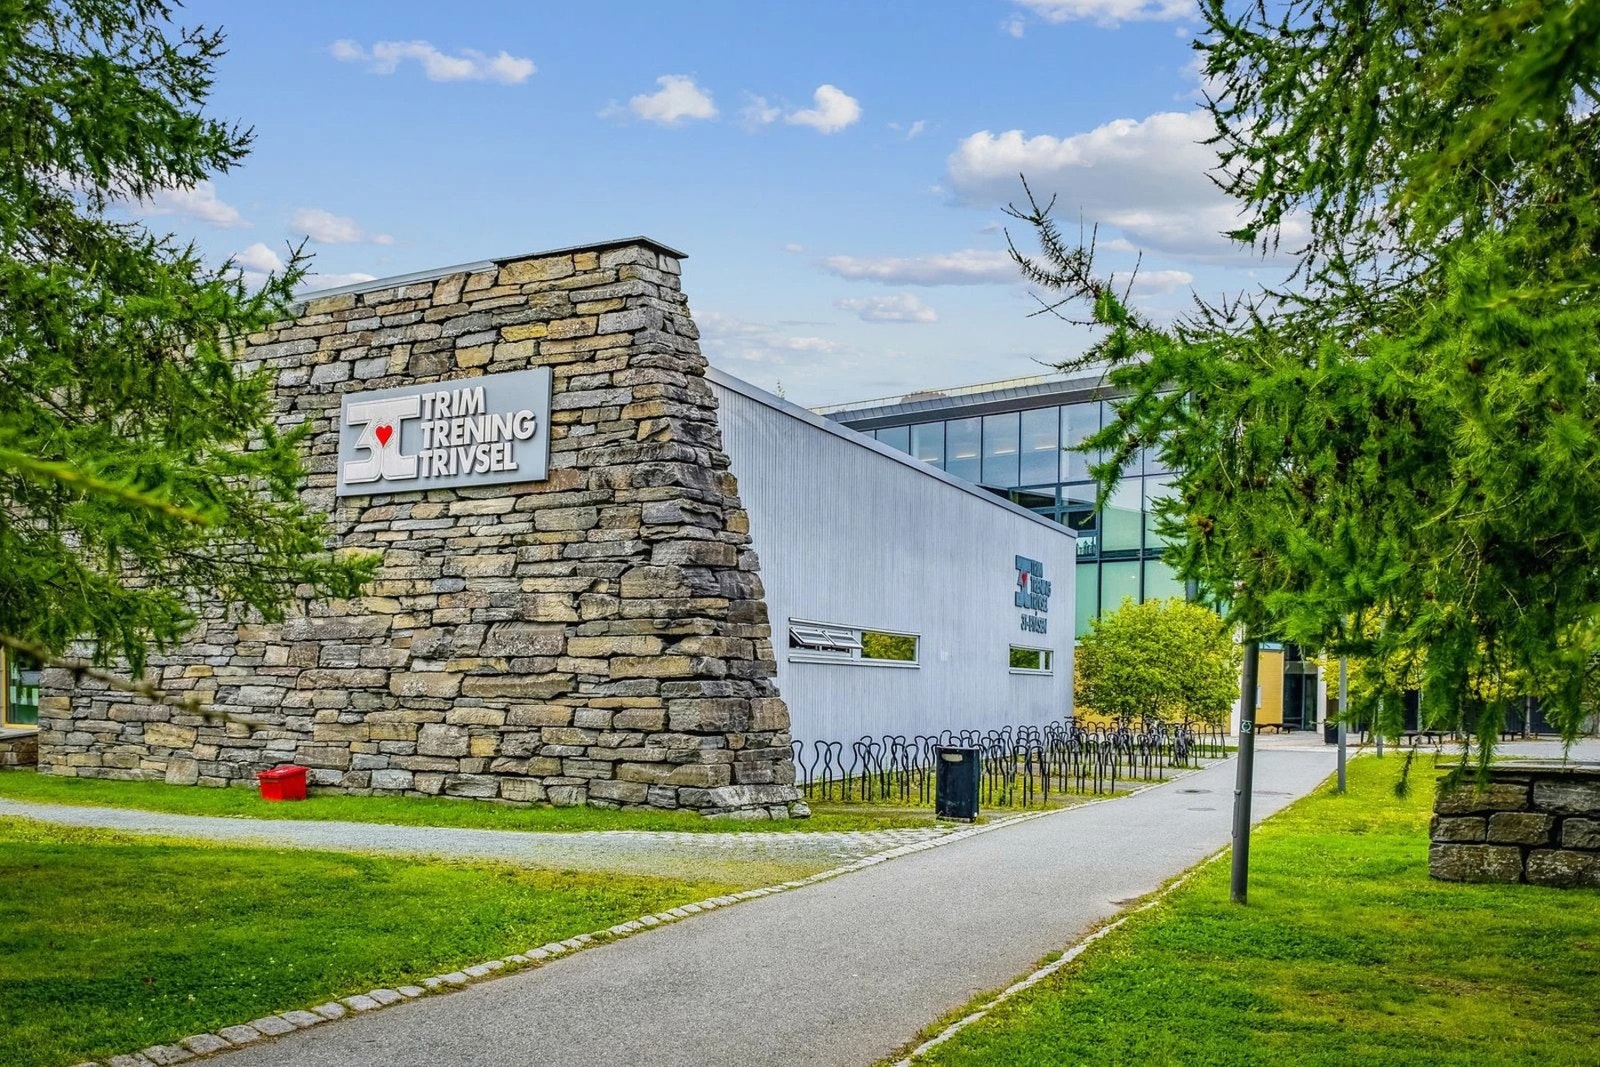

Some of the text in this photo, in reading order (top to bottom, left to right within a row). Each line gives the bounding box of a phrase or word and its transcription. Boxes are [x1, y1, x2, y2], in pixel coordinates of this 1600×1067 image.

[422, 386, 486, 420] TRIM
[421, 410, 537, 449] TRENING
[420, 442, 518, 478] TRIVSEL
